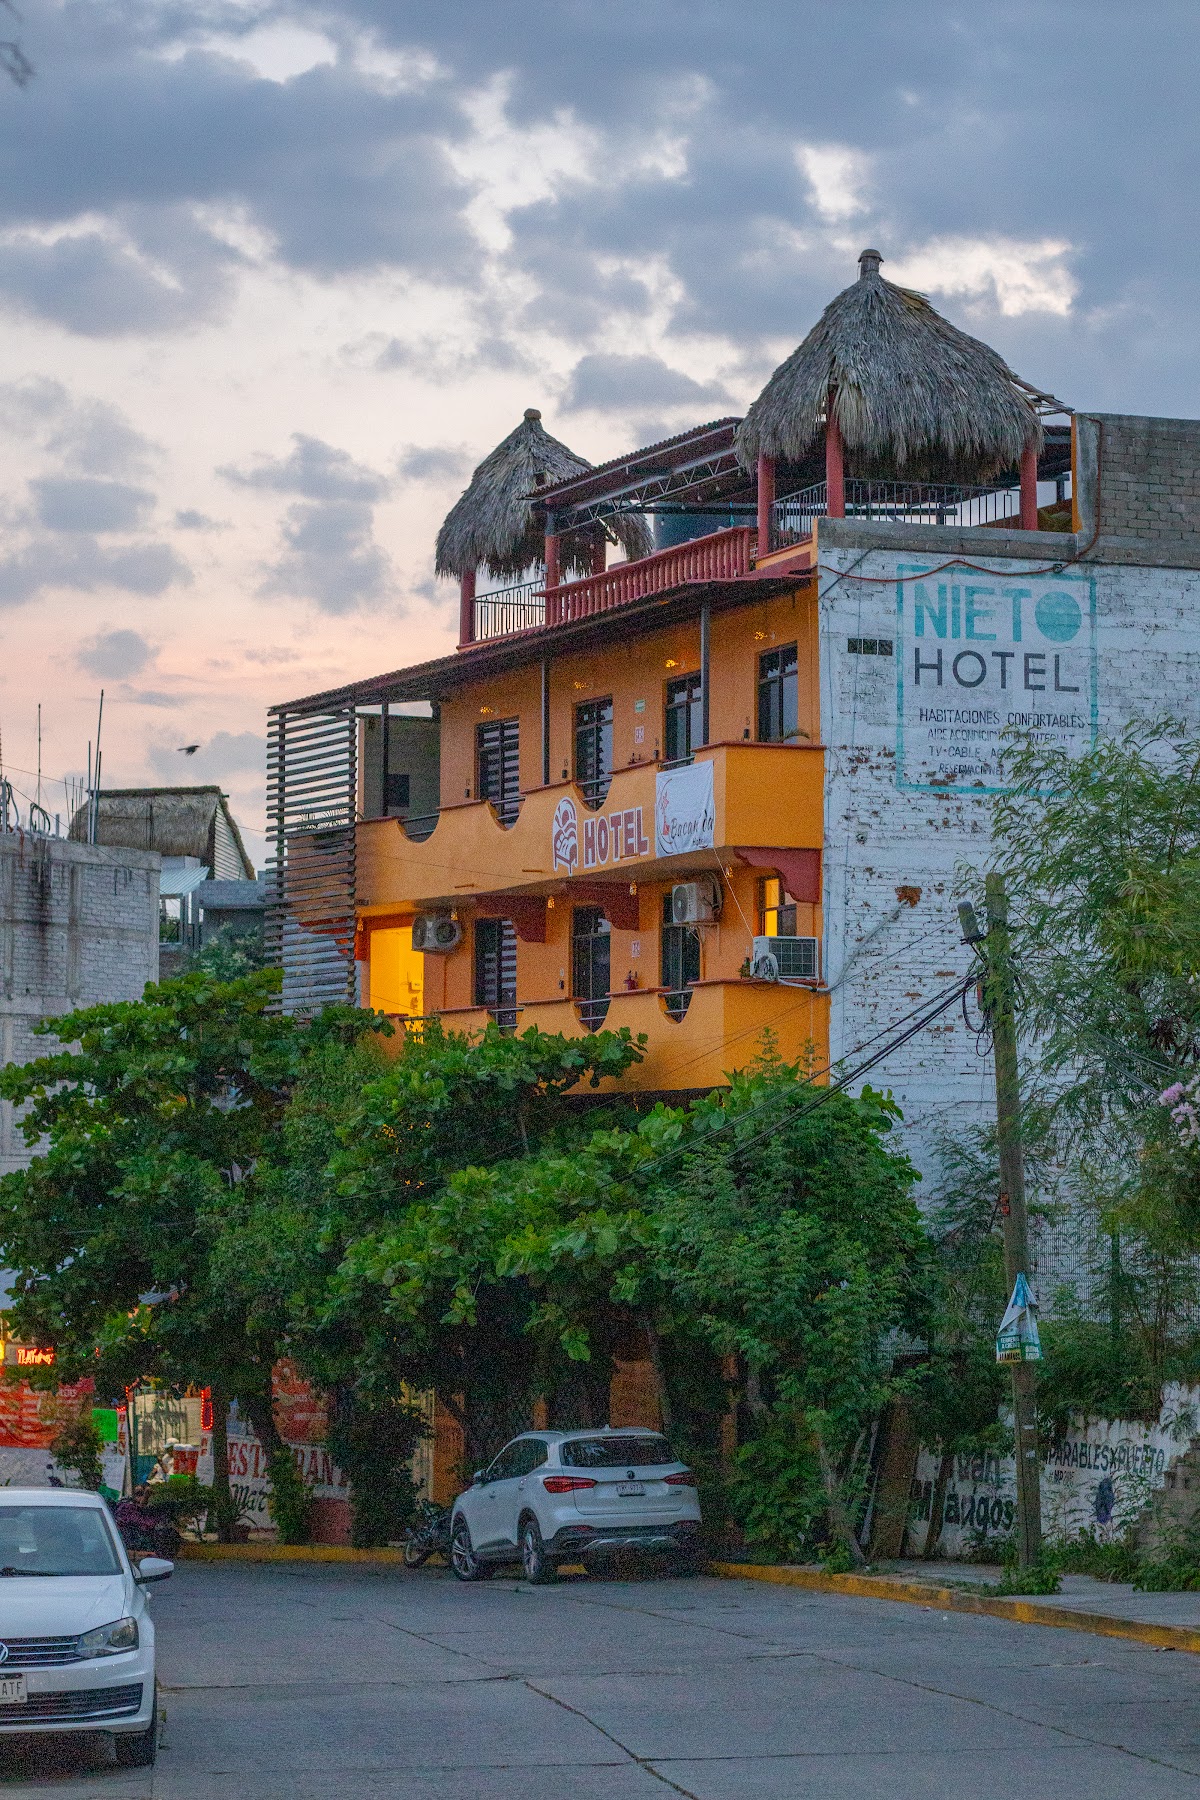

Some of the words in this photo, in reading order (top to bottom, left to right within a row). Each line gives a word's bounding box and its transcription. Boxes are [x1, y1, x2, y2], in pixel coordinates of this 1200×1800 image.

[914, 583, 1082, 643] NIETO
[914, 647, 1080, 692] HOTEL
[919, 708, 1000, 725] HABITACIONES
[1007, 712, 1086, 729] CONFORTABLES
[584, 806, 649, 868] HOTEL
